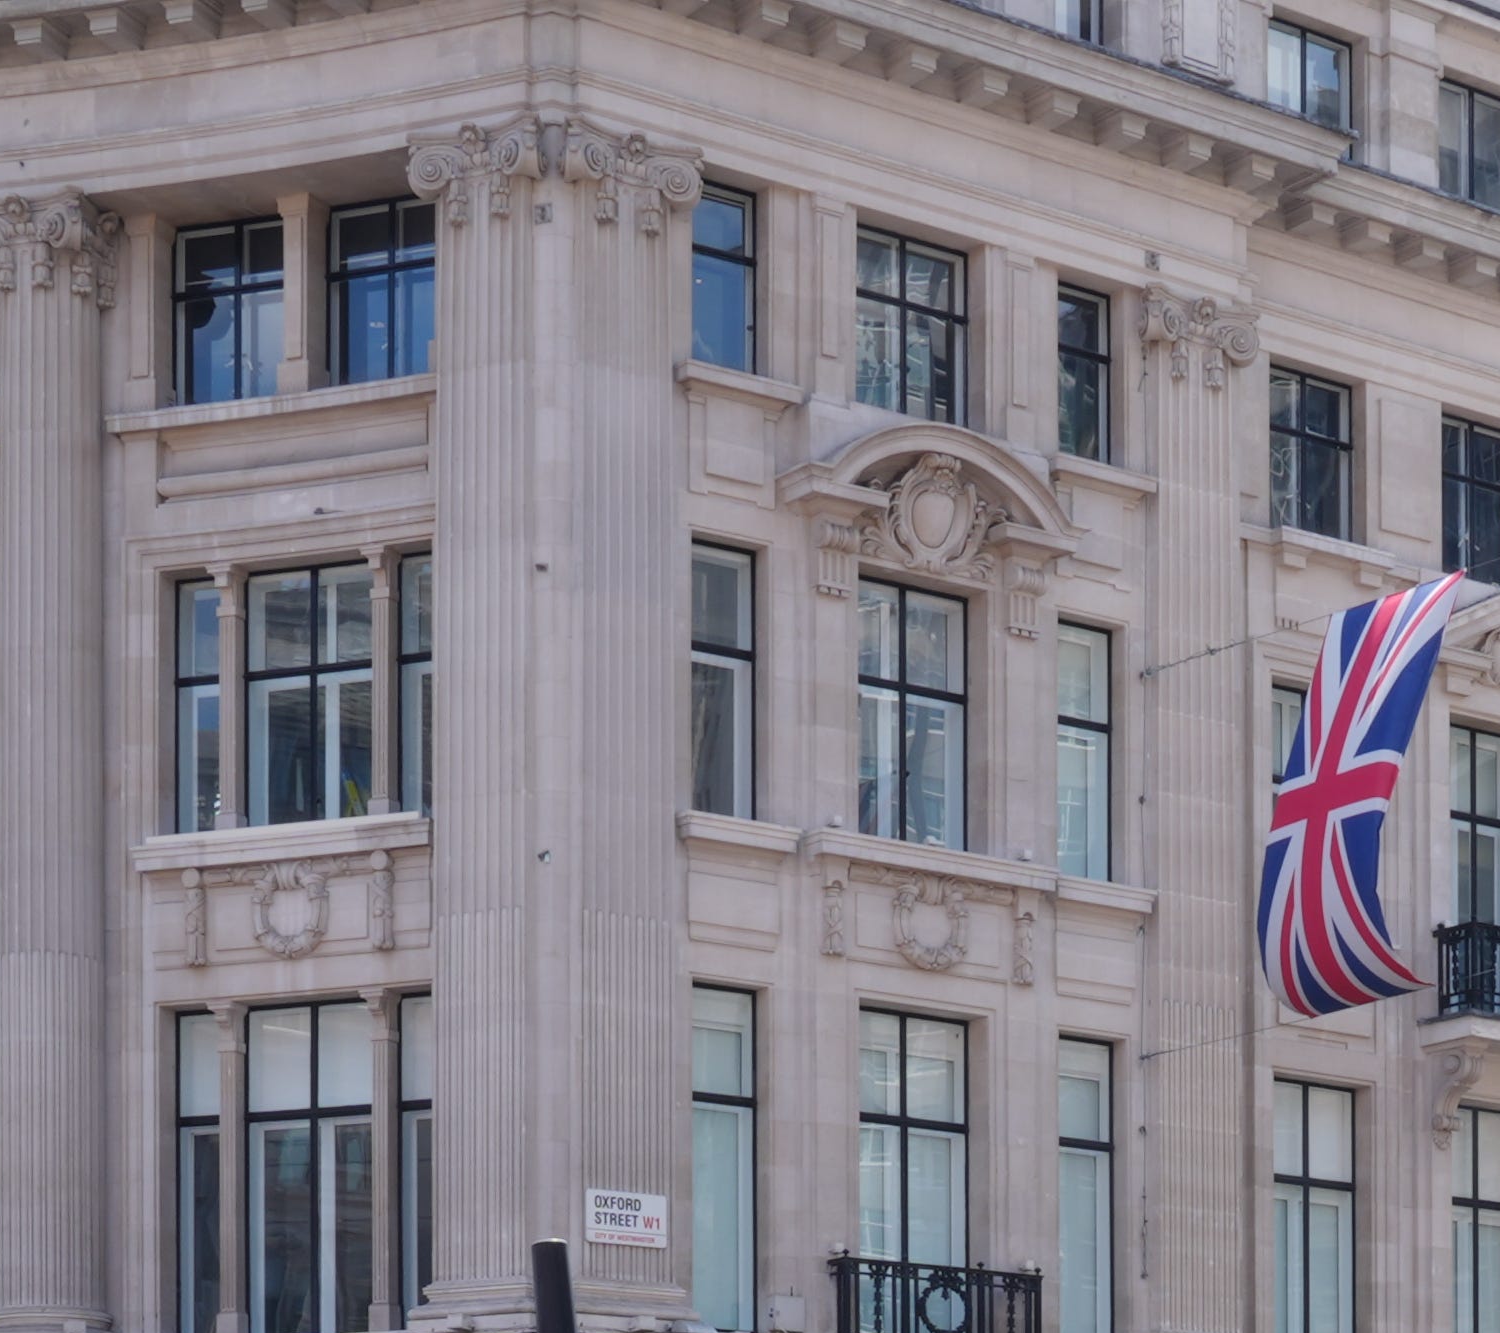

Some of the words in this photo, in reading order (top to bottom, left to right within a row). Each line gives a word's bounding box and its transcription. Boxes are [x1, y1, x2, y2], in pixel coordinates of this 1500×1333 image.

[594, 1194, 642, 1212] OXFORD
[594, 1211, 639, 1228] STREET
[642, 1215, 661, 1230] W1
